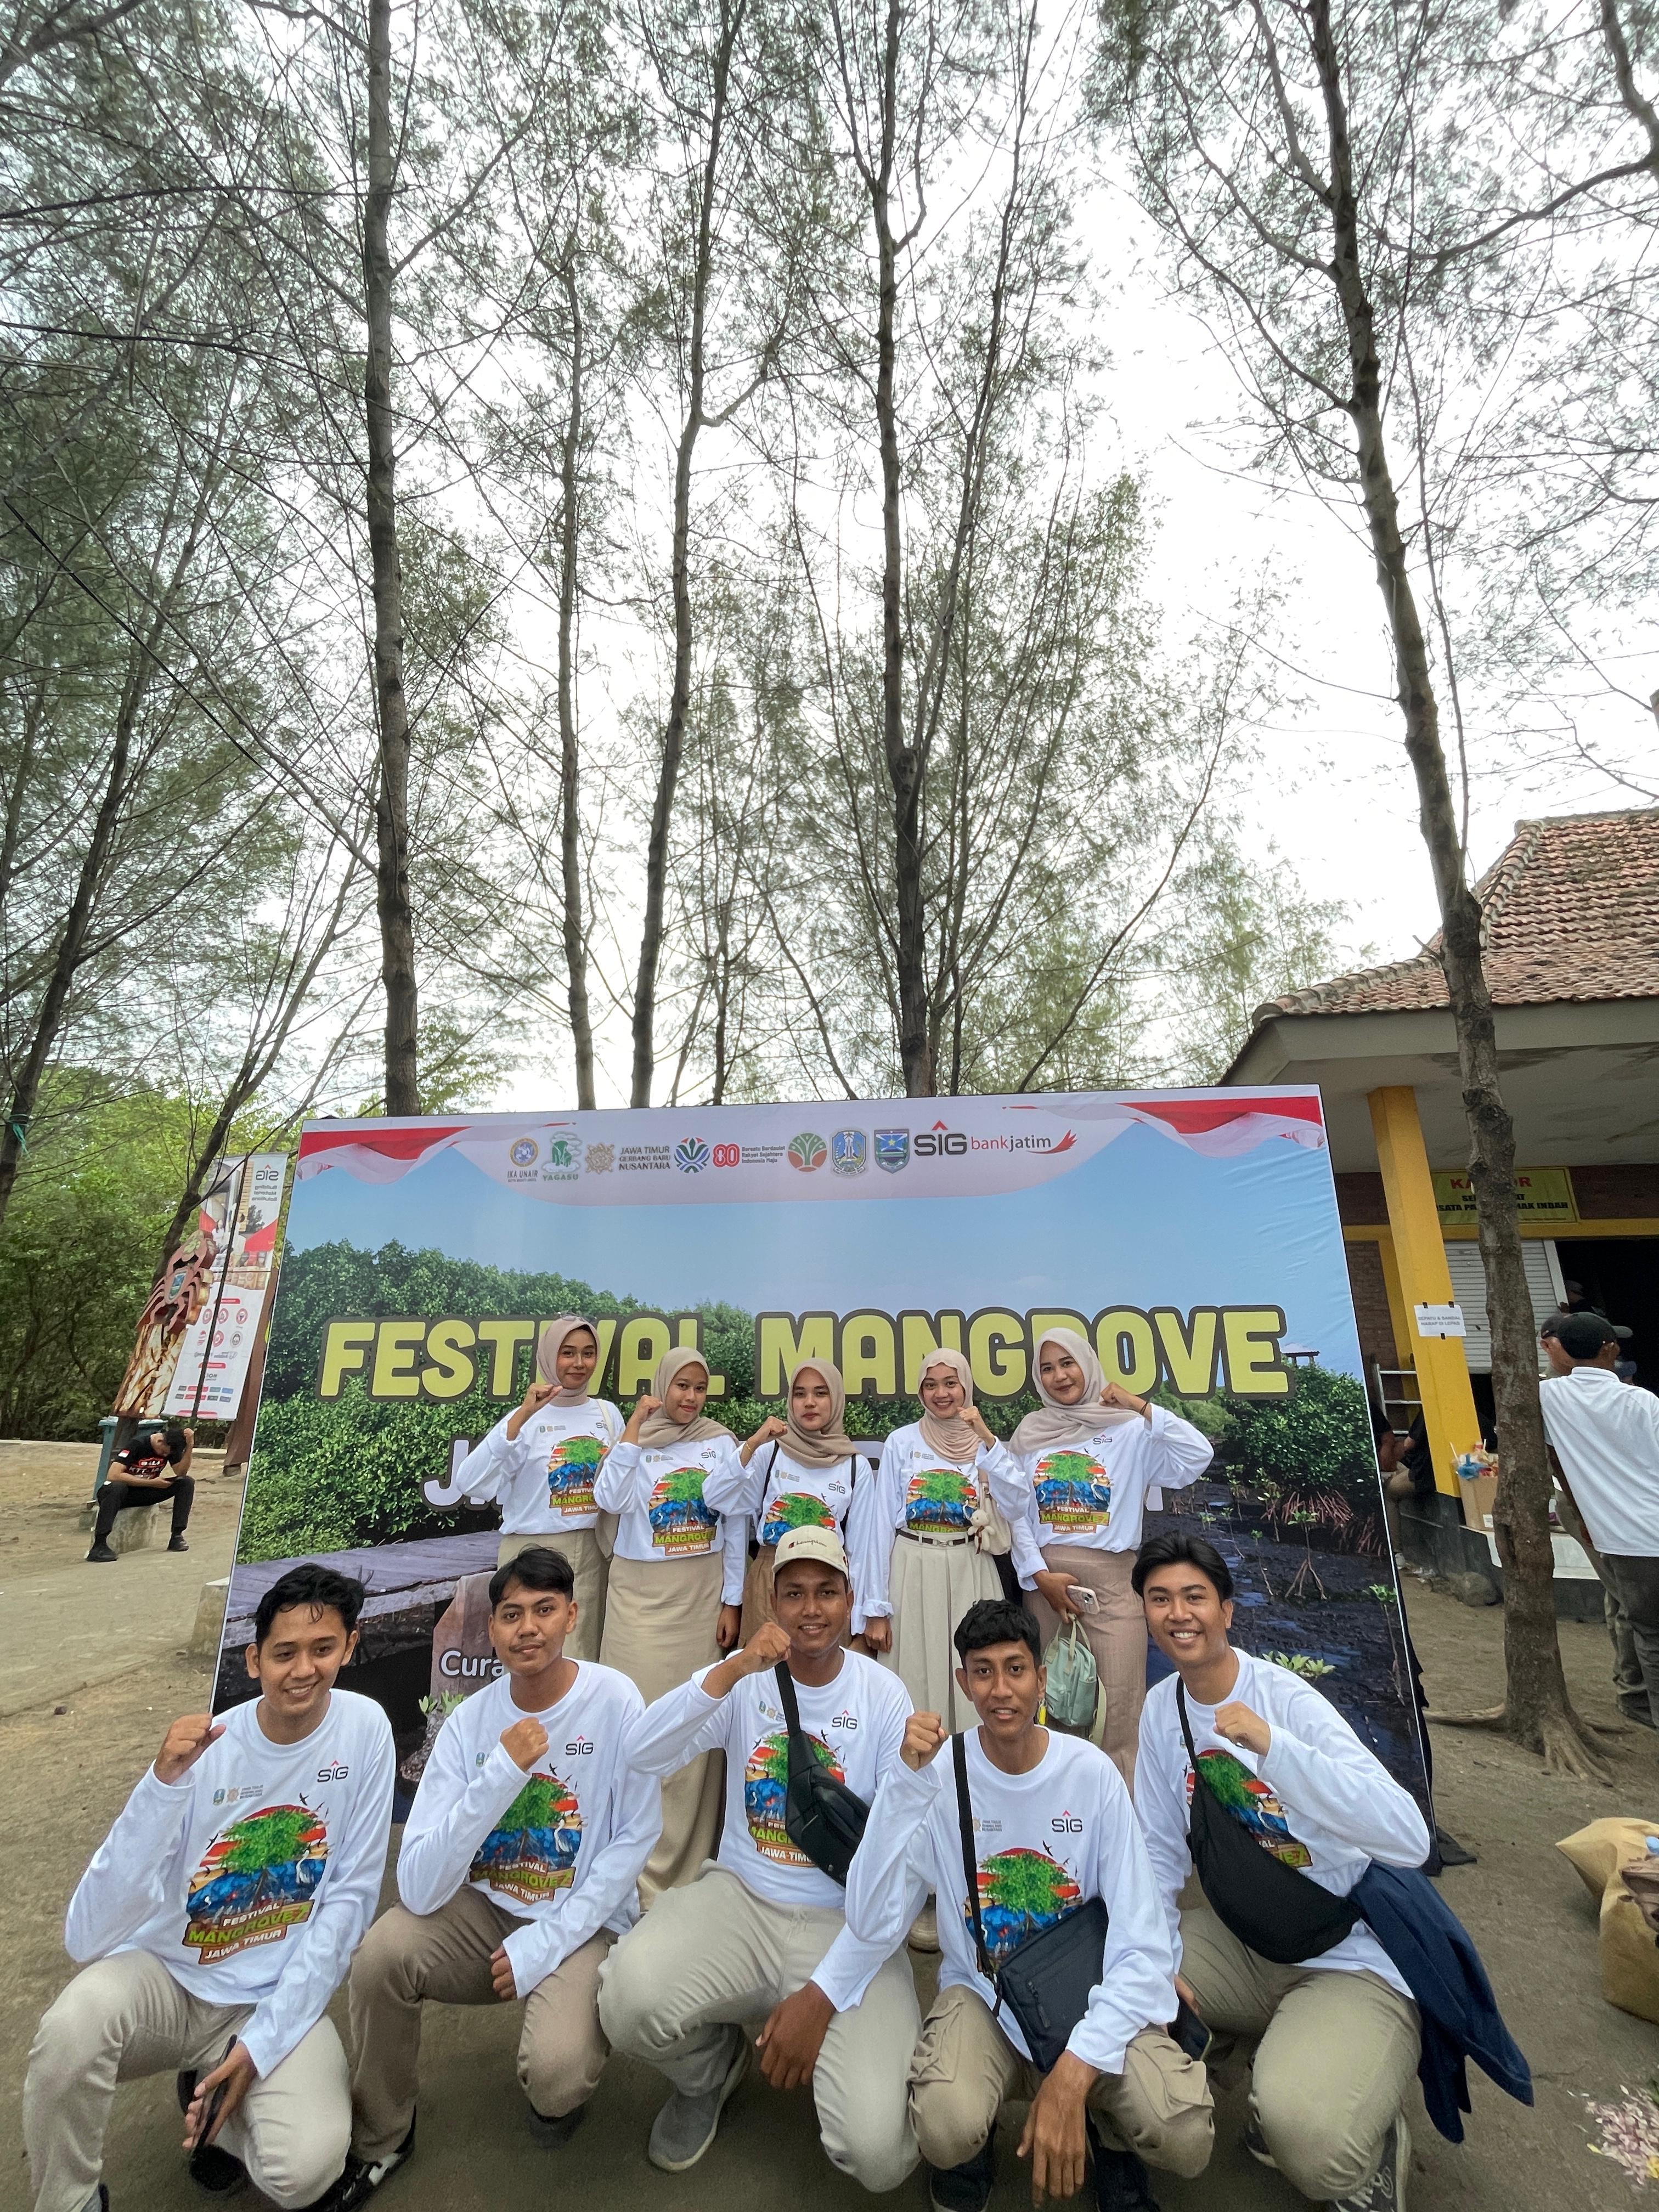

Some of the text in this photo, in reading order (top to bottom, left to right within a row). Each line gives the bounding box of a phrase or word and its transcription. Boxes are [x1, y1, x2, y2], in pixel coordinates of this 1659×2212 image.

[913, 1133, 967, 1156] SIG
[971, 1135, 1052, 1153] bankjatim
[713, 1144, 740, 1167] 80
[619, 1162, 670, 1170] NUSANTARA
[520, 1170, 538, 1178] UNAIR
[760, 1311, 1289, 1396] MANGOVE
[828, 1483, 846, 1494] SIG
[1042, 1513, 1098, 1523] MANGROVE
[690, 1543, 709, 1551] TIMUR
[832, 1716, 857, 1730] SIG
[566, 1742, 594, 1756] SIG
[317, 1766, 349, 1782] SIG
[1052, 1818, 1083, 1833] SIG
[222, 1902, 281, 1927] FESTIVAL
[188, 1910, 293, 1943] MANGROVE
[204, 1929, 282, 1959] JAWA TIMUR
